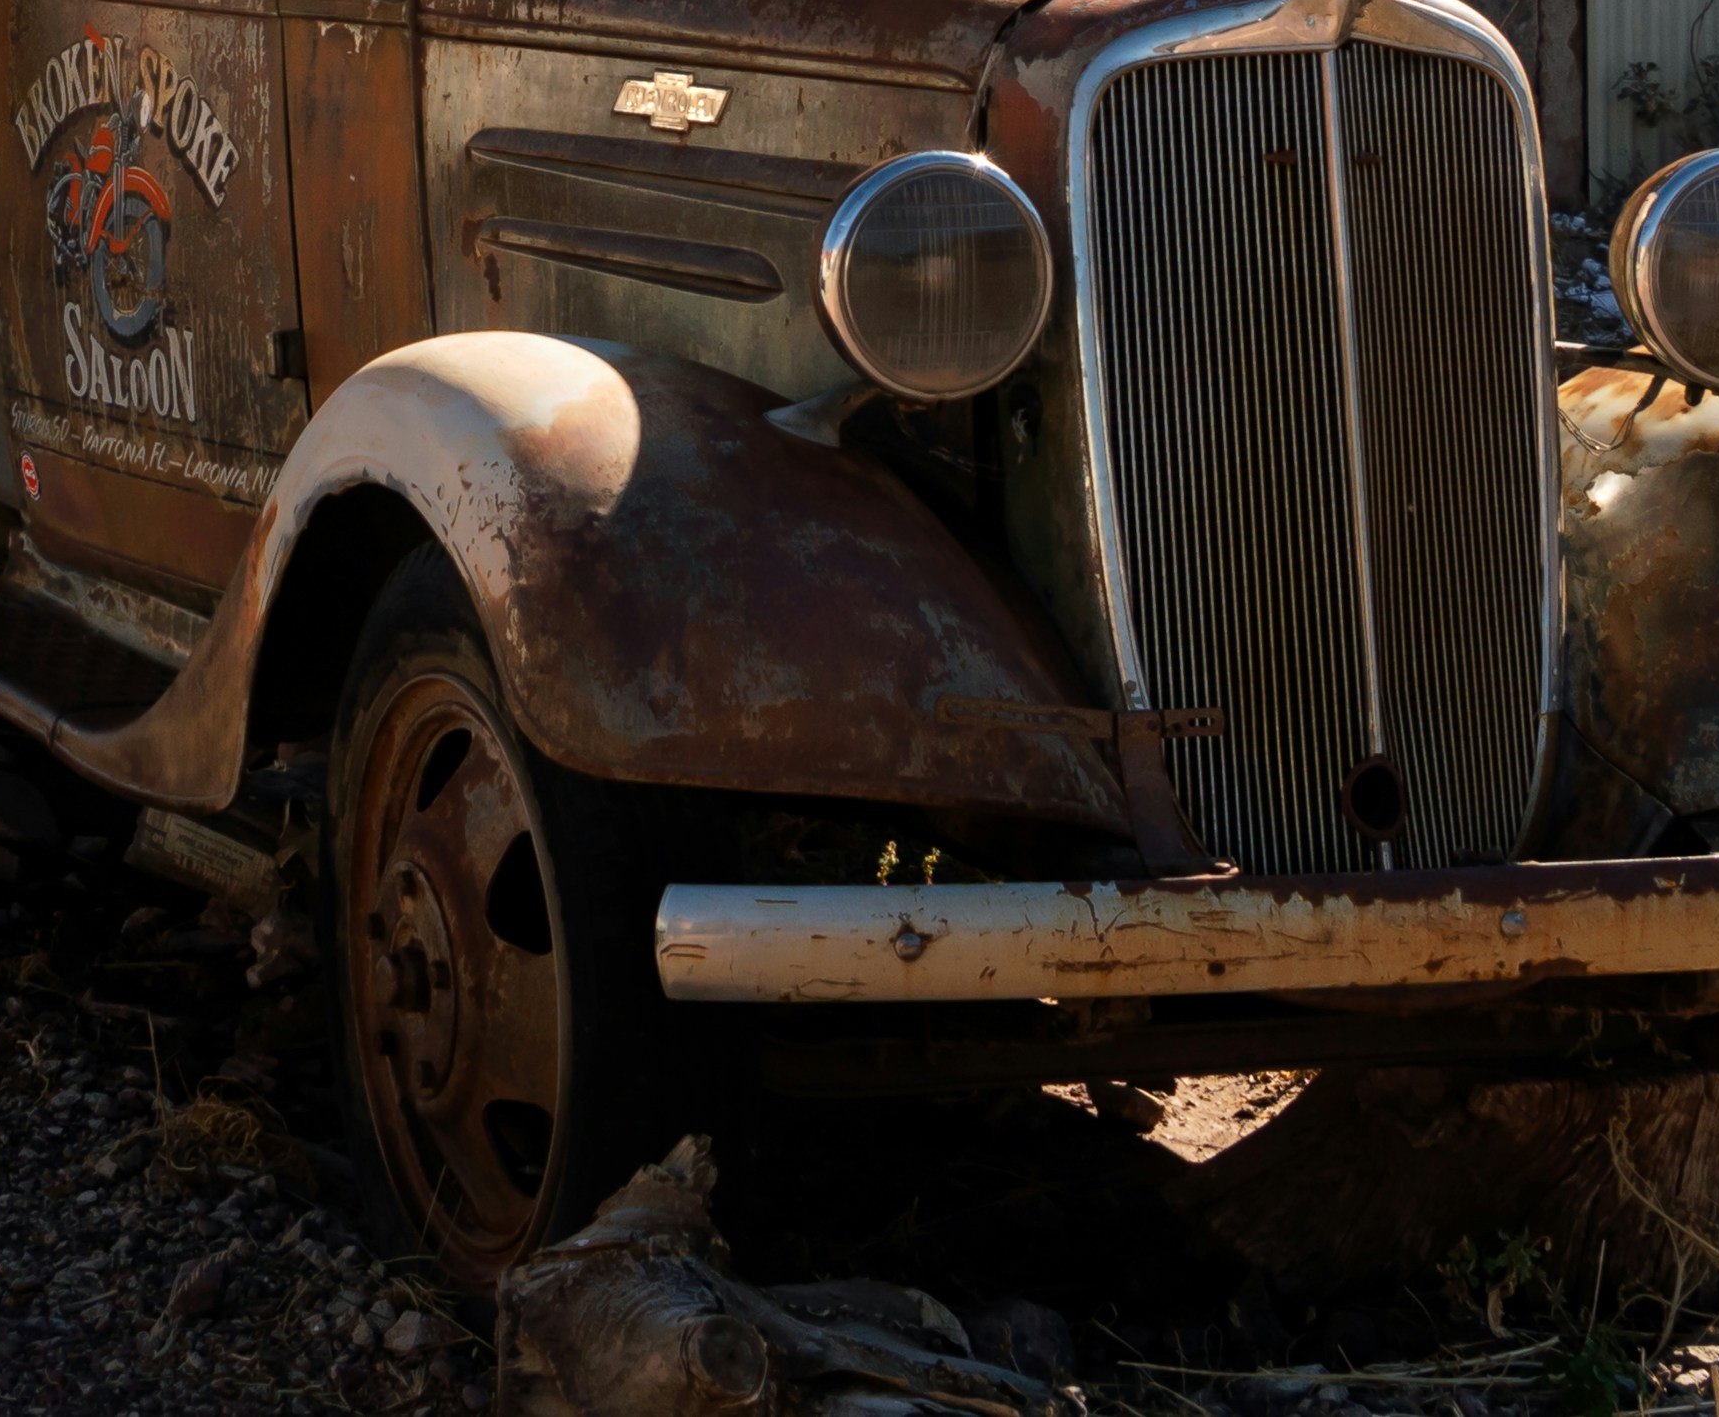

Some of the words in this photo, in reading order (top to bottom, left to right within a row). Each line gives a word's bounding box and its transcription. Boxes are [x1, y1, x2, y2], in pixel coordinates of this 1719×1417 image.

[15, 34, 124, 171] BROKEN
[140, 46, 241, 207] SPOKE
[63, 301, 196, 422] SALOON
